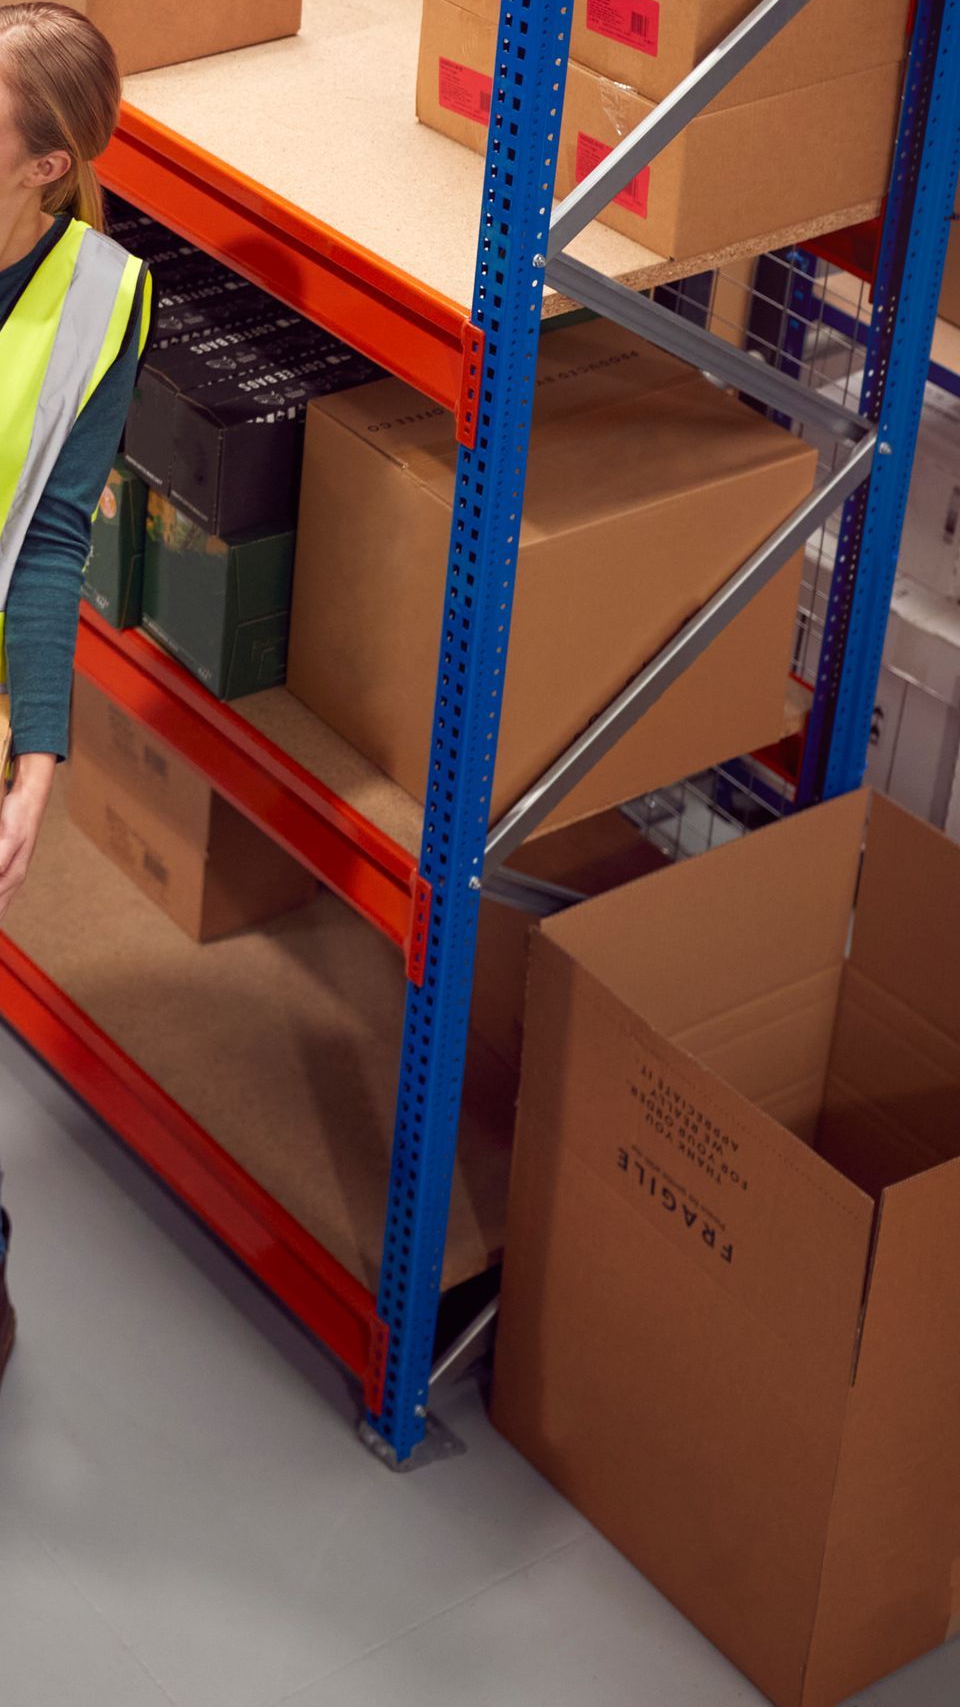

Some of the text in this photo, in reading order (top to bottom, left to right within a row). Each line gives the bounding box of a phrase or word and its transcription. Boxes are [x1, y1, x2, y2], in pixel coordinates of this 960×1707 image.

[189, 324, 277, 355] COFFEE BAGS
[238, 360, 326, 392] COFFEE BAGS
[558, 350, 639, 379] PRODUCED
[395, 408, 445, 426] OFFEE
[650, 1088, 723, 1157] WE REALLY
[658, 1079, 739, 1151] APPRECIATE
[645, 1113, 722, 1184] THANK YOU
[678, 1128, 715, 1162] YOUR
[721, 1163, 748, 1191] FOR
[617, 1147, 733, 1263] FRAGILE
